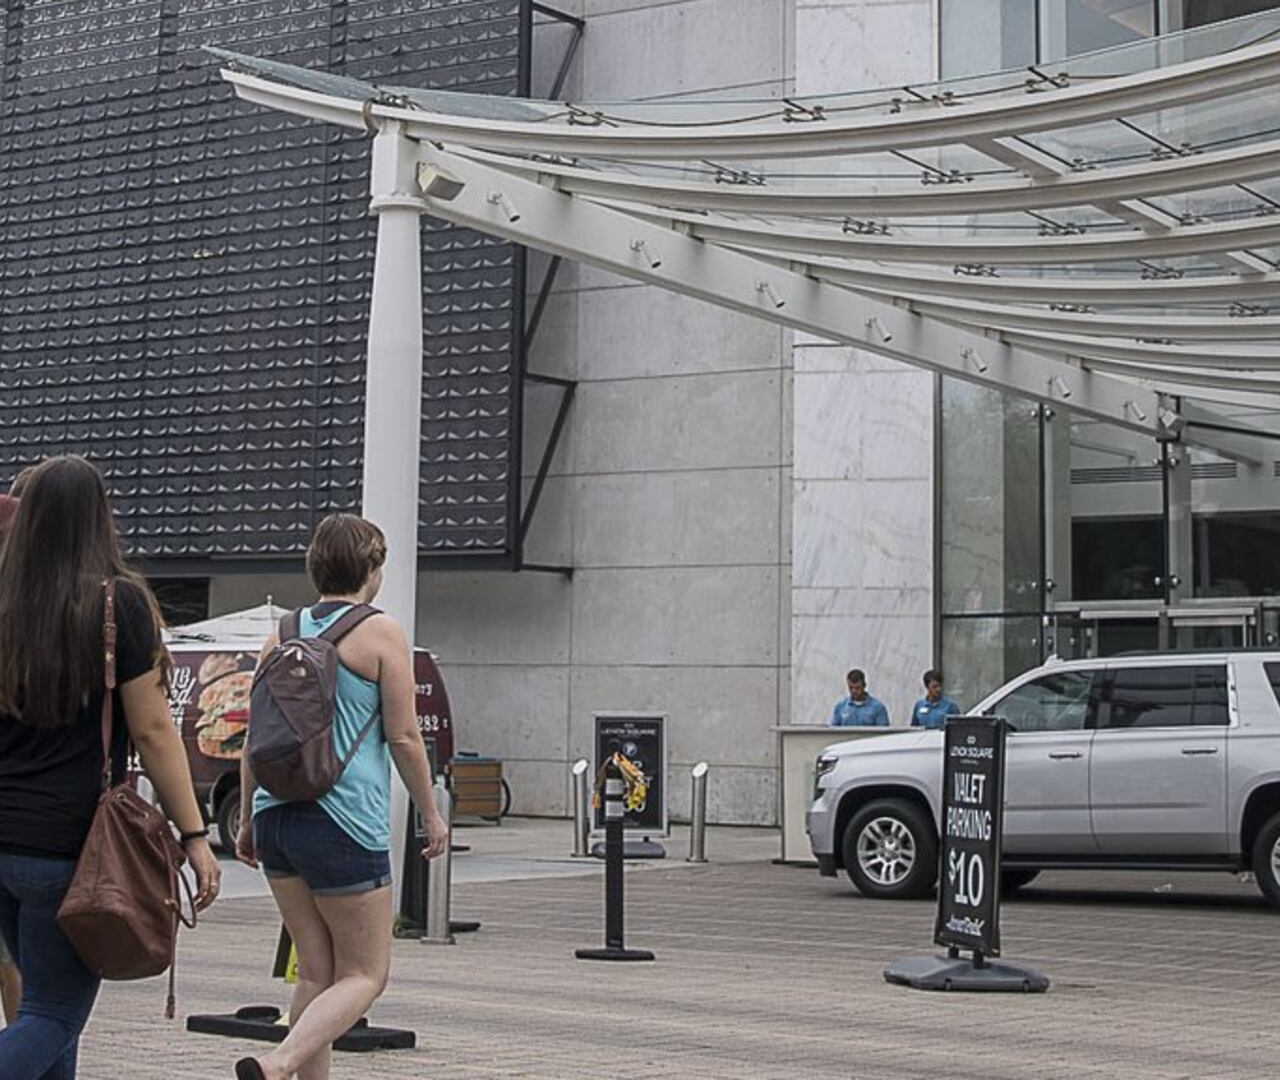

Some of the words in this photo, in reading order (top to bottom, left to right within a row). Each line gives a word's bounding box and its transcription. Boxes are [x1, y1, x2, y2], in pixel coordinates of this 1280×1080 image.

[954, 772, 986, 804] VALET
[947, 806, 992, 841] PARKING
[948, 847, 984, 907] $10
